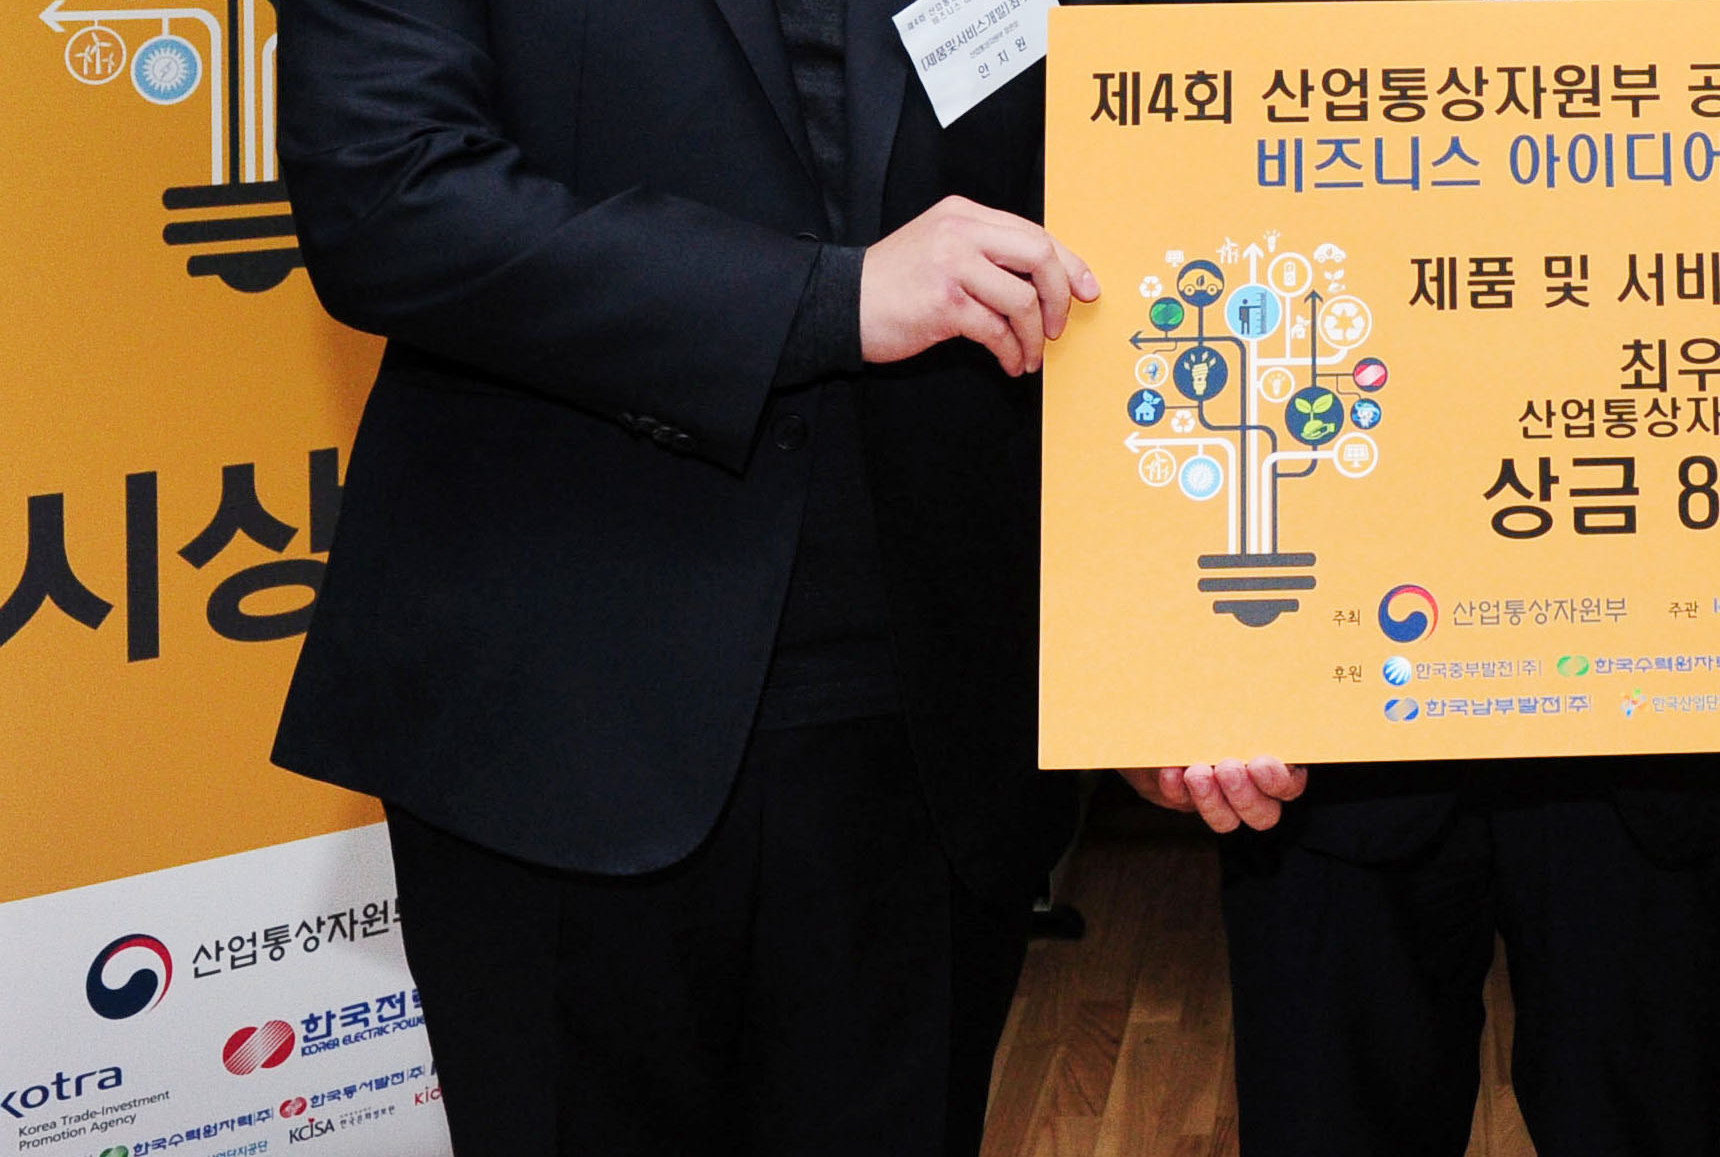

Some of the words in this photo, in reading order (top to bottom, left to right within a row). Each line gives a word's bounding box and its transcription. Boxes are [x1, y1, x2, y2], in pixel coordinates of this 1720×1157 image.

[1091, 68, 1233, 127] 제4회
[1261, 63, 1664, 122] 산업통상자원부
[1255, 134, 1482, 194] 비즈니스
[1408, 255, 1515, 311] 제품
[1544, 255, 1590, 308] 및
[1482, 455, 1640, 540] 상금
[1332, 609, 1361, 627] 주최
[1452, 597, 1628, 627] 산업통상자원부
[1668, 601, 1699, 619] 주관
[1332, 665, 1362, 683] 후원
[392, 1015, 426, 1033] POWE
[18, 1120, 57, 1138] Korea
[60, 1090, 171, 1126] Trade-Investment
[19, 1126, 87, 1151] Promotion
[90, 1113, 138, 1135] Agency
